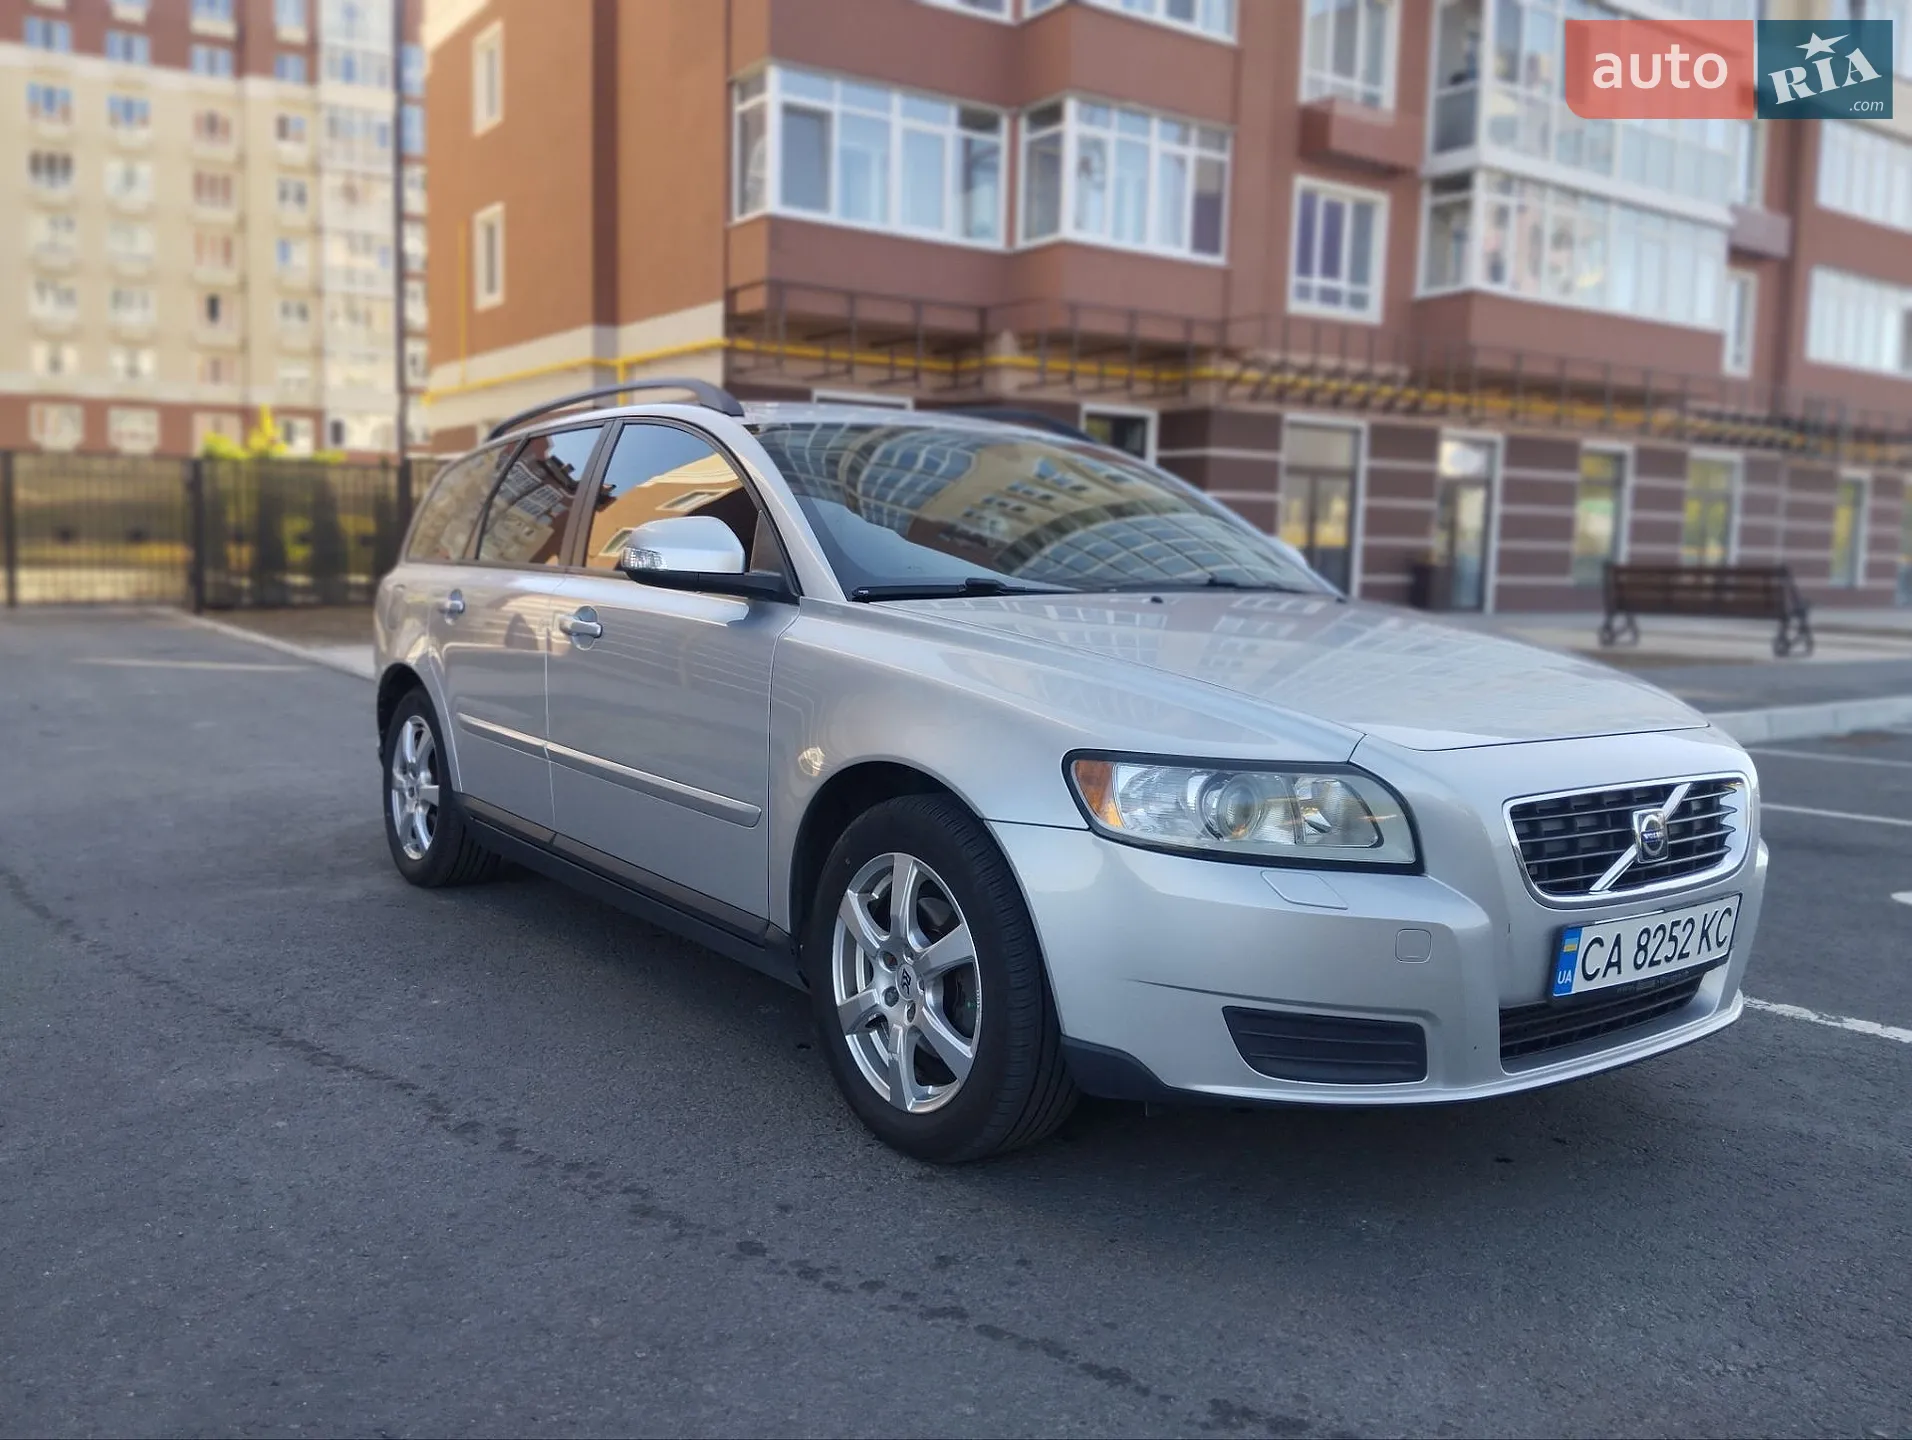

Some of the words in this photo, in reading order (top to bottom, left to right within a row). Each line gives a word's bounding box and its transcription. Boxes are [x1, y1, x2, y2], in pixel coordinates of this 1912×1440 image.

[1582, 933, 1622, 981] CA
[1633, 917, 1696, 970] 8252
[1697, 907, 1732, 955] KC
[1557, 970, 1572, 984] UA
